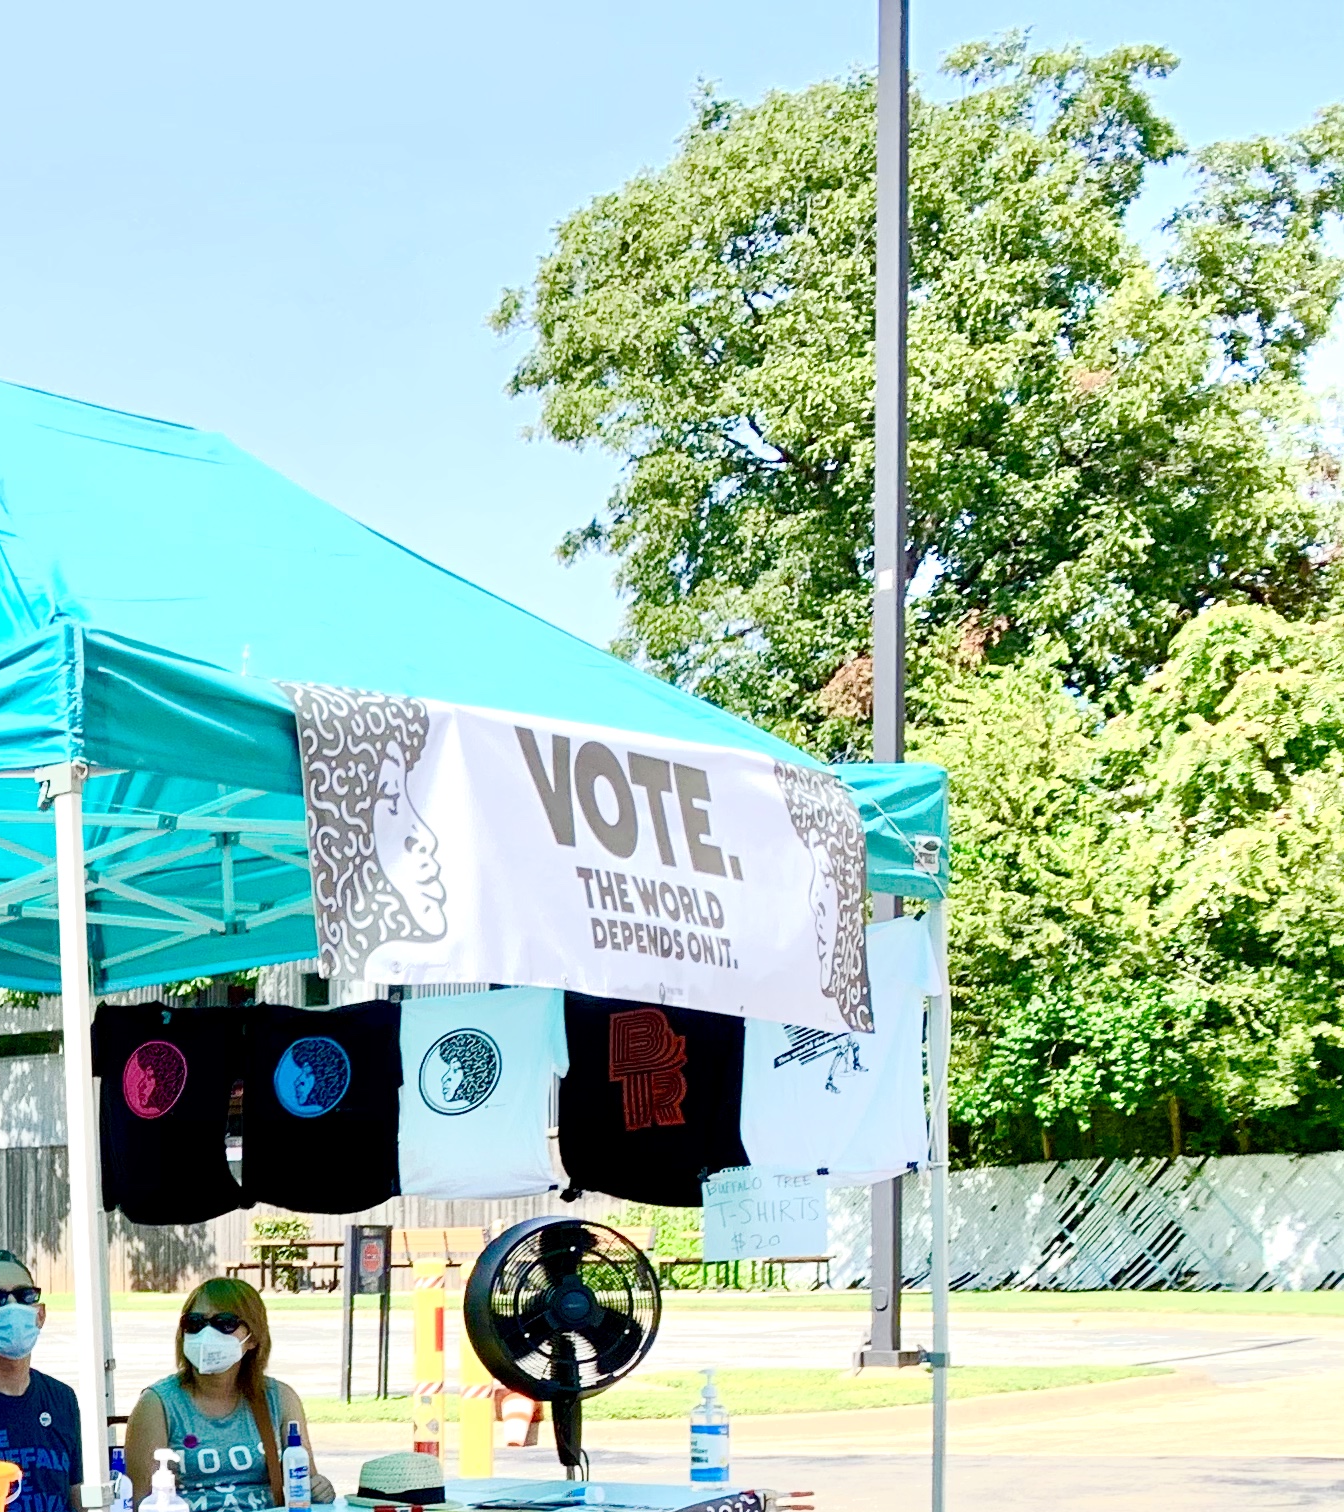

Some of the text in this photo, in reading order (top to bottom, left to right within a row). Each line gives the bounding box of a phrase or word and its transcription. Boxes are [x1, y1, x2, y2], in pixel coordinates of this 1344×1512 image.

[513, 724, 744, 881] VOTE.
[576, 866, 725, 930] THE WORLD
[591, 917, 739, 970] DEPENDS ON IT.
[705, 1174, 812, 1196] BUFFALO TREE
[707, 1196, 820, 1228] T-SHIRTS
